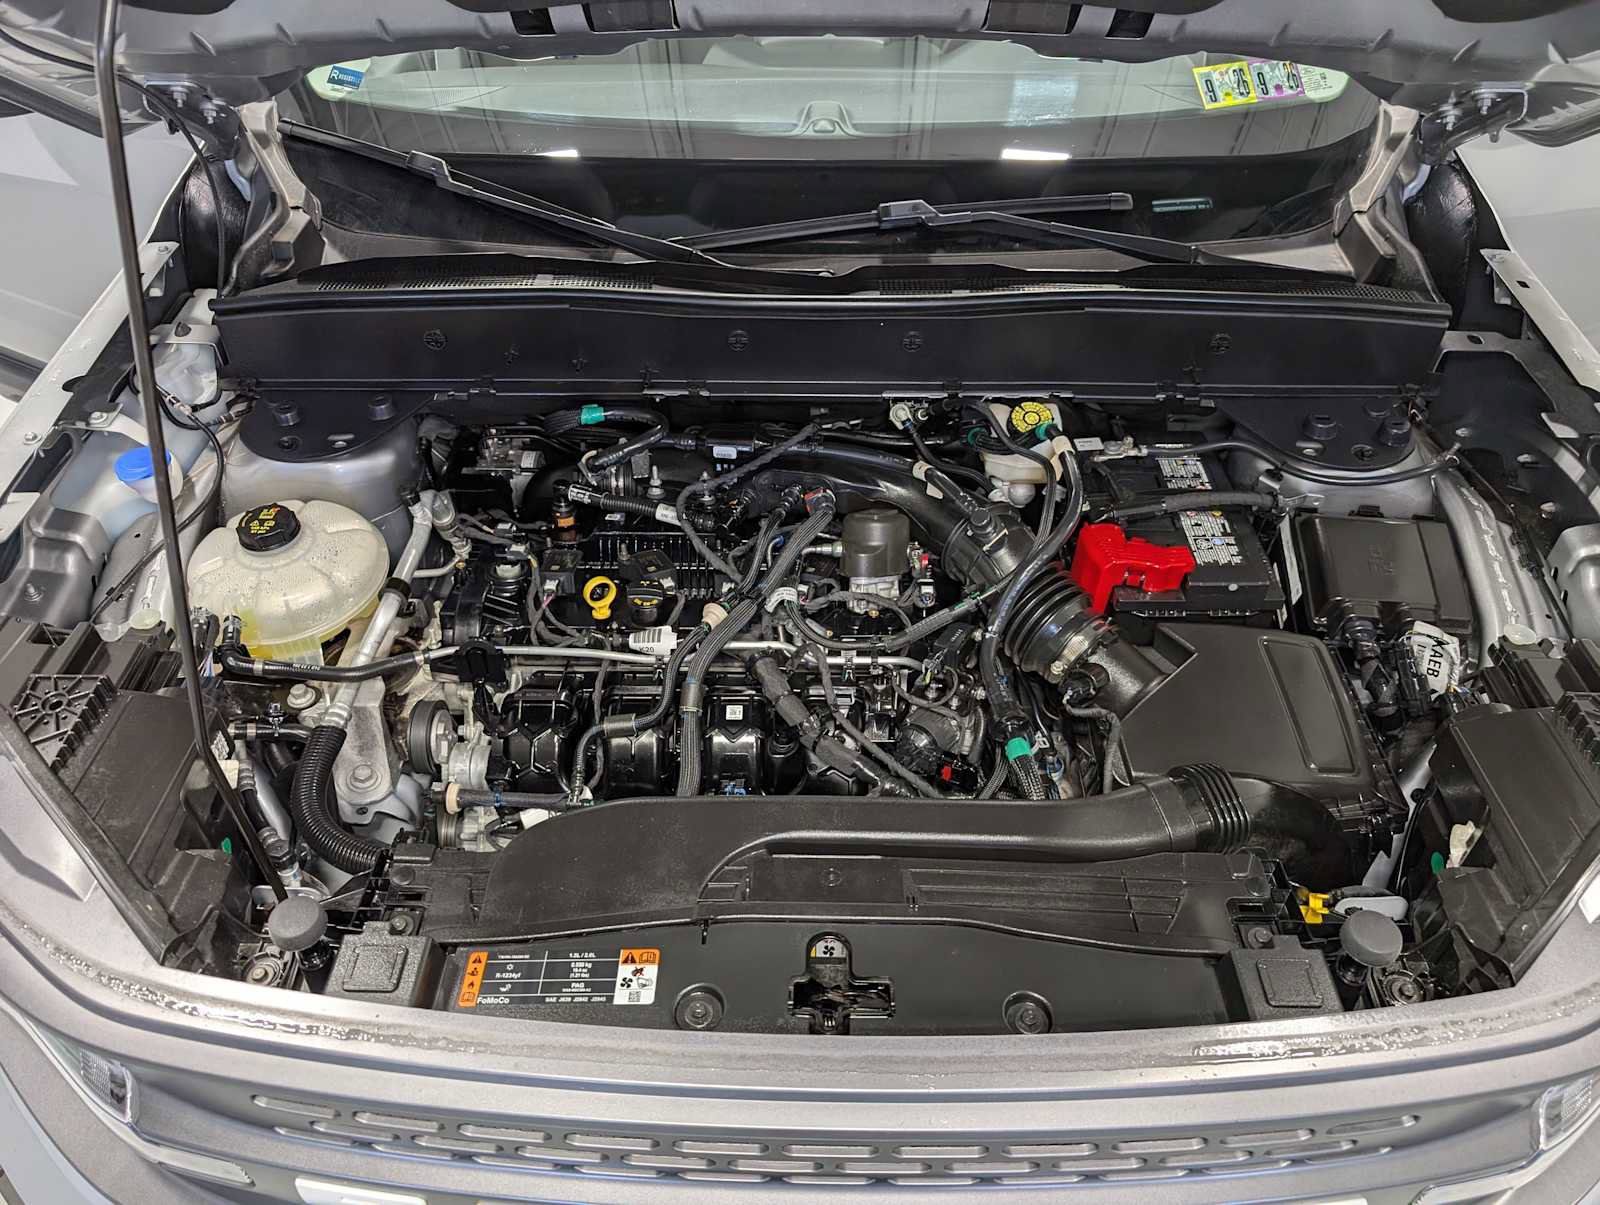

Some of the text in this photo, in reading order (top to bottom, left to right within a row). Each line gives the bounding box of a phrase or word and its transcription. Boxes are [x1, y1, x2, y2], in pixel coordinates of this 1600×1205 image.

[1205, 68, 1250, 102] 9 26
[1257, 72, 1269, 95] 9
[1283, 62, 1299, 89] 26
[477, 996, 510, 1004] FoMoCo
